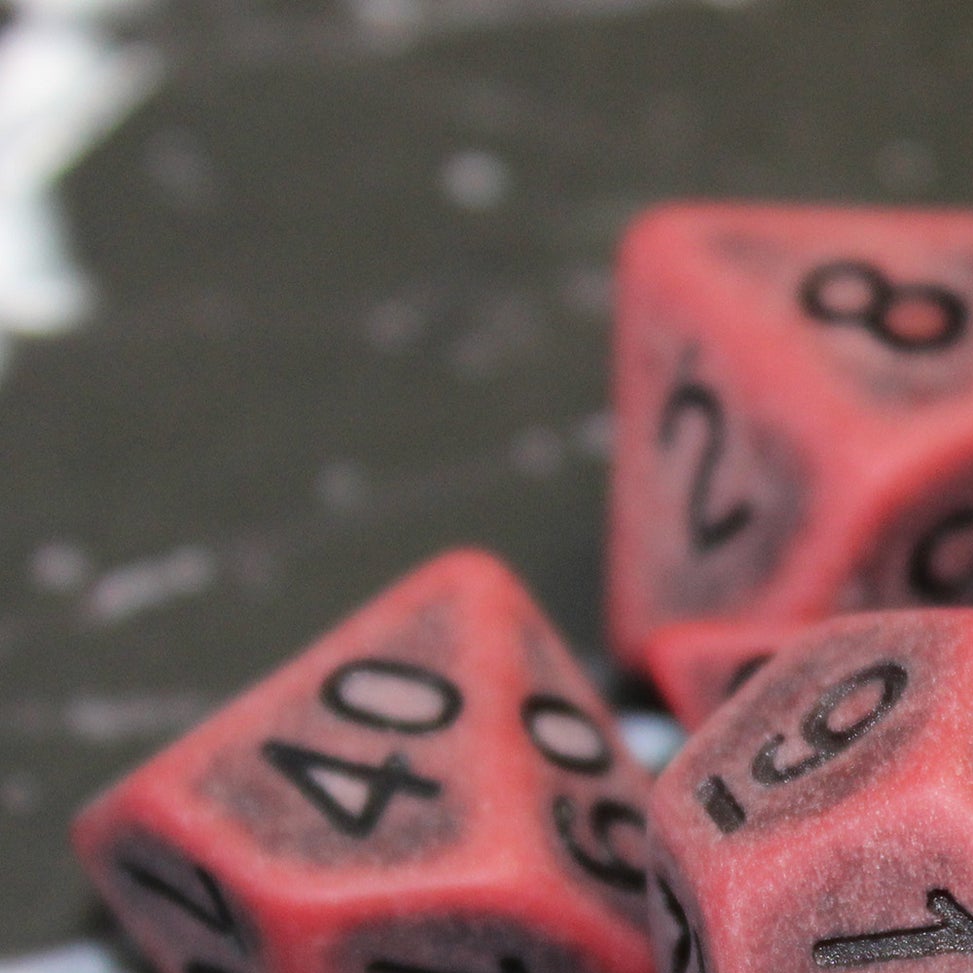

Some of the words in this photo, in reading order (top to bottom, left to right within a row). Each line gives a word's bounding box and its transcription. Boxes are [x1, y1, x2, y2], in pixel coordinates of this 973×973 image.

[802, 260, 967, 352] 8
[659, 385, 752, 551] 2
[260, 658, 463, 838] 40
[700, 660, 908, 834] 9
